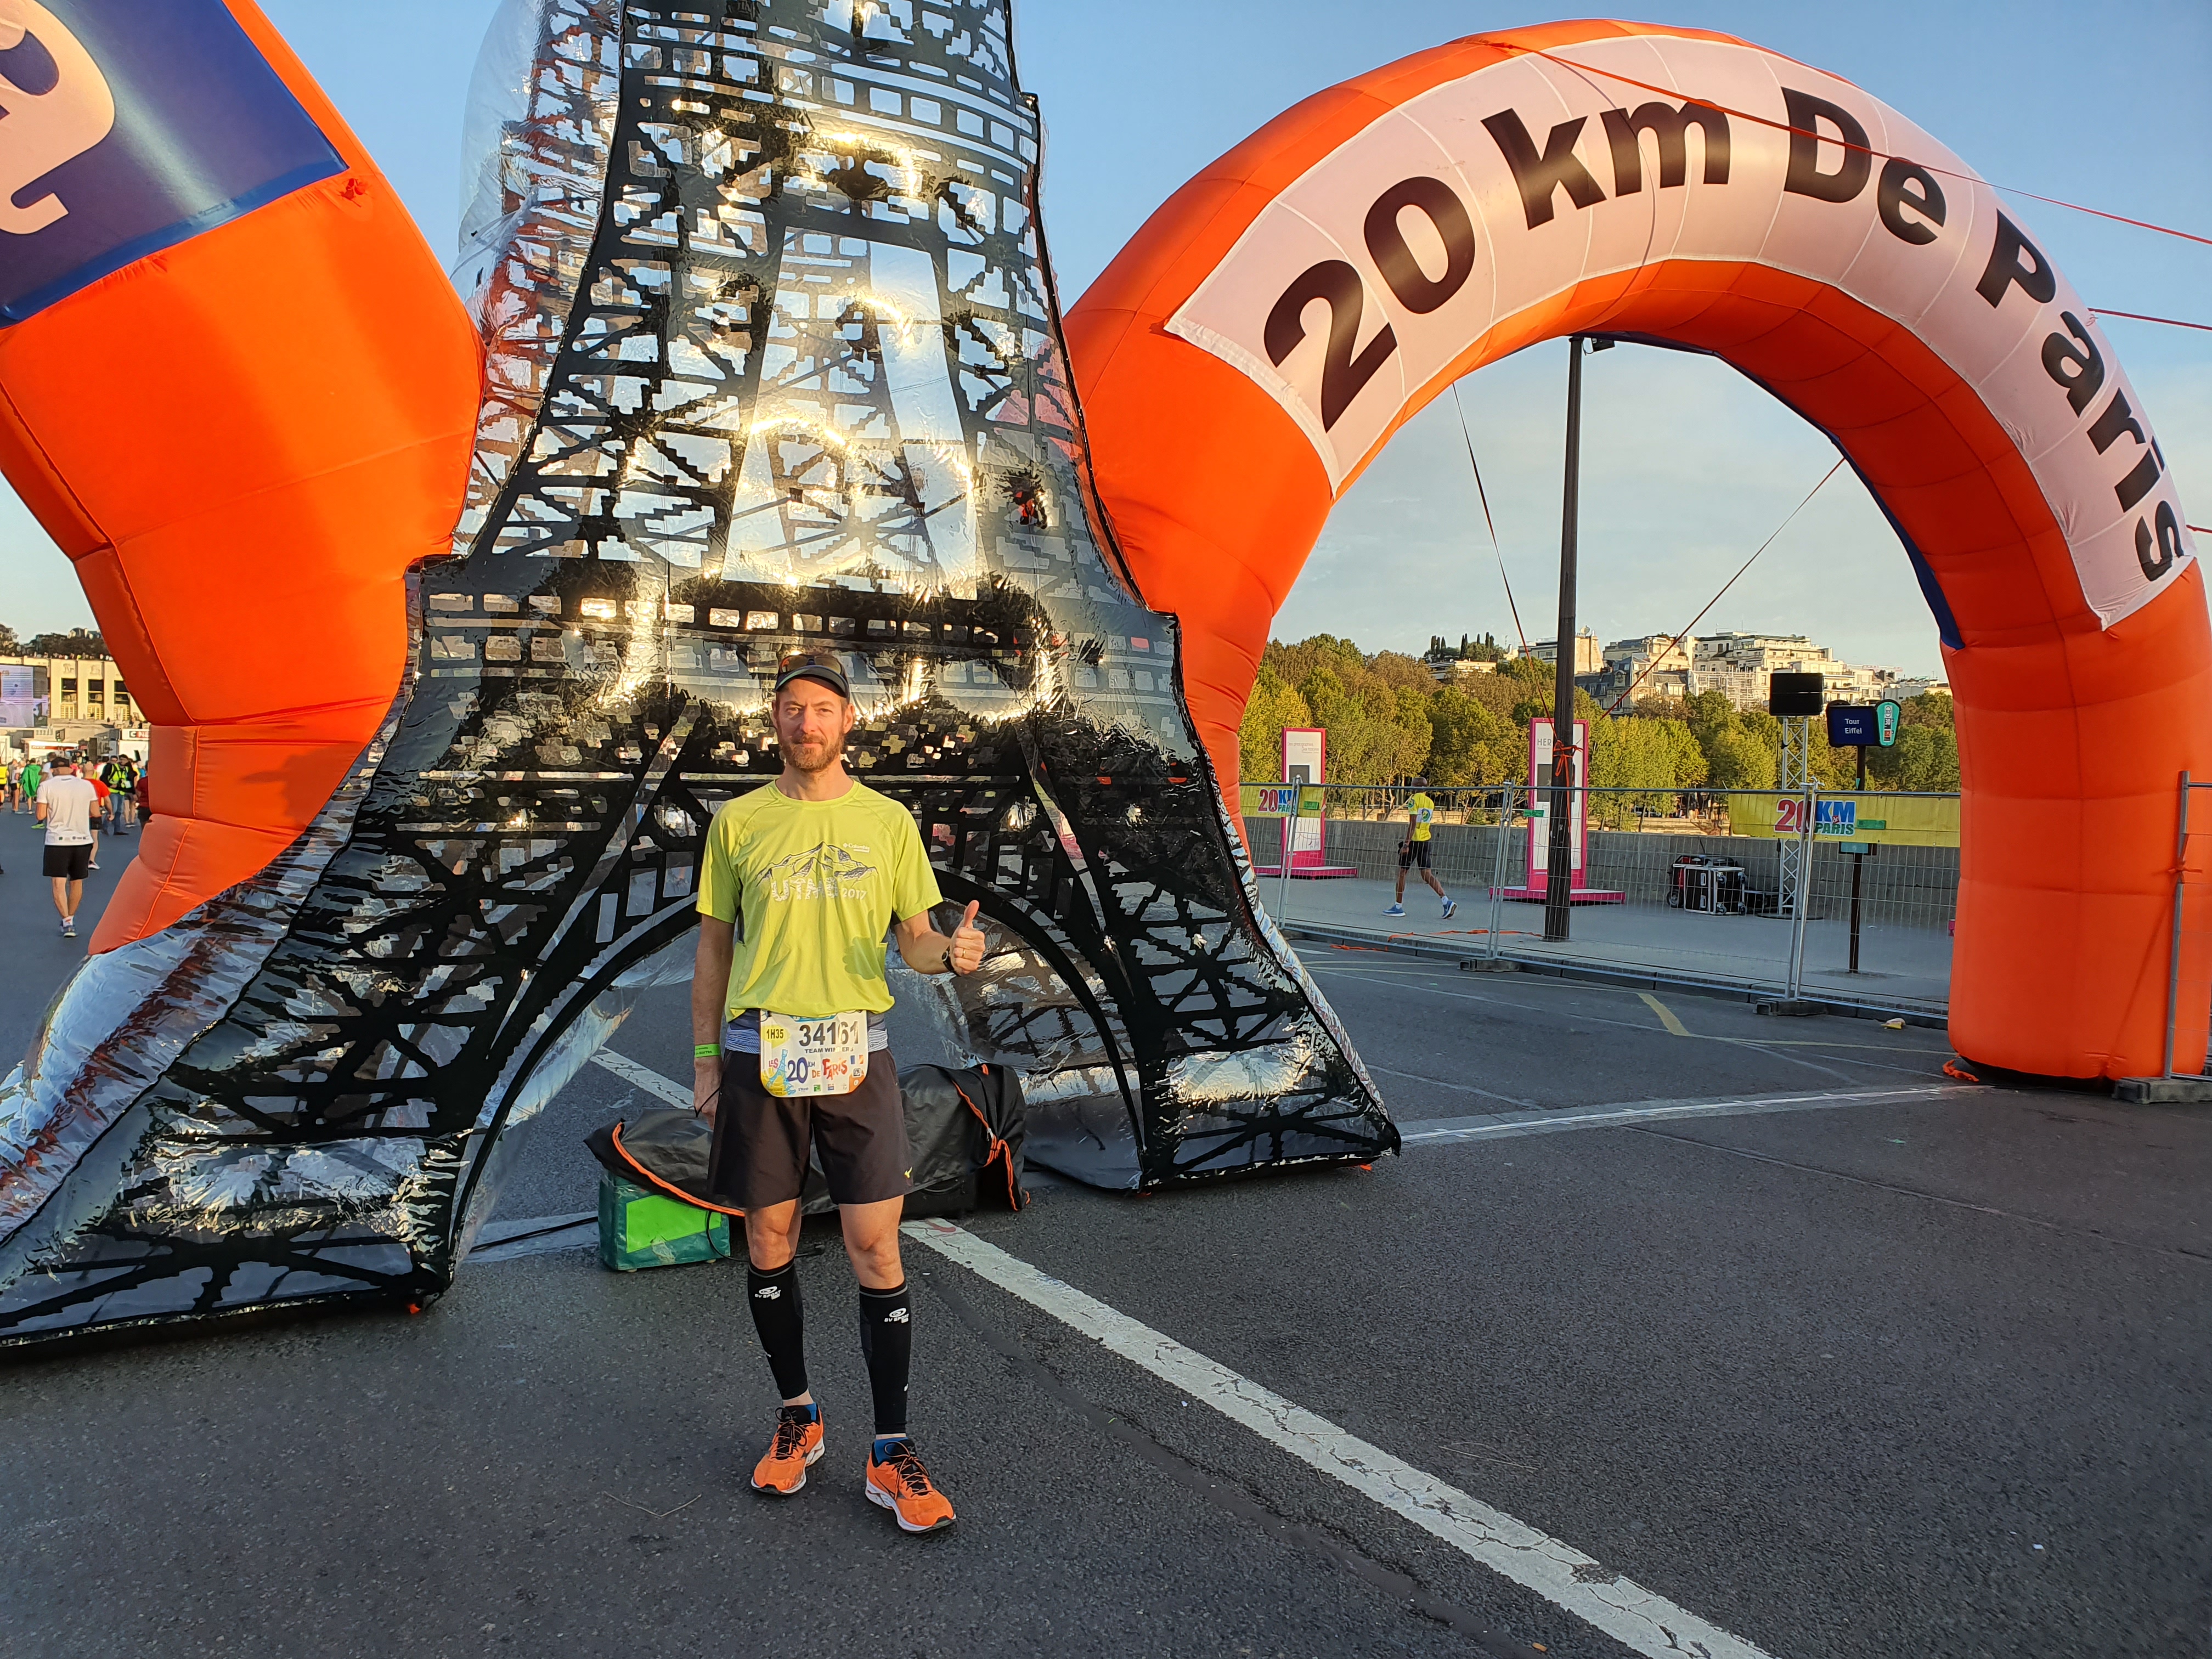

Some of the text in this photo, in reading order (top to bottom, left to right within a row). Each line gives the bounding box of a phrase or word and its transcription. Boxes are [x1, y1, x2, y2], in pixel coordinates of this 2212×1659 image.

[1264, 86, 2185, 583] 20 km De Paris
[1258, 789, 1278, 812] 20
[1774, 799, 1855, 833] 20 KM
[1815, 823, 1854, 835] PARIS
[771, 877, 838, 902] UTMB
[842, 888, 867, 900] 2017
[766, 1028, 785, 1040] 1H35
[798, 1021, 859, 1047] 34161
[769, 1058, 779, 1069] LES
[787, 1057, 809, 1084] 20
[811, 1070, 821, 1079] DE
[822, 1057, 848, 1081] PARIS
